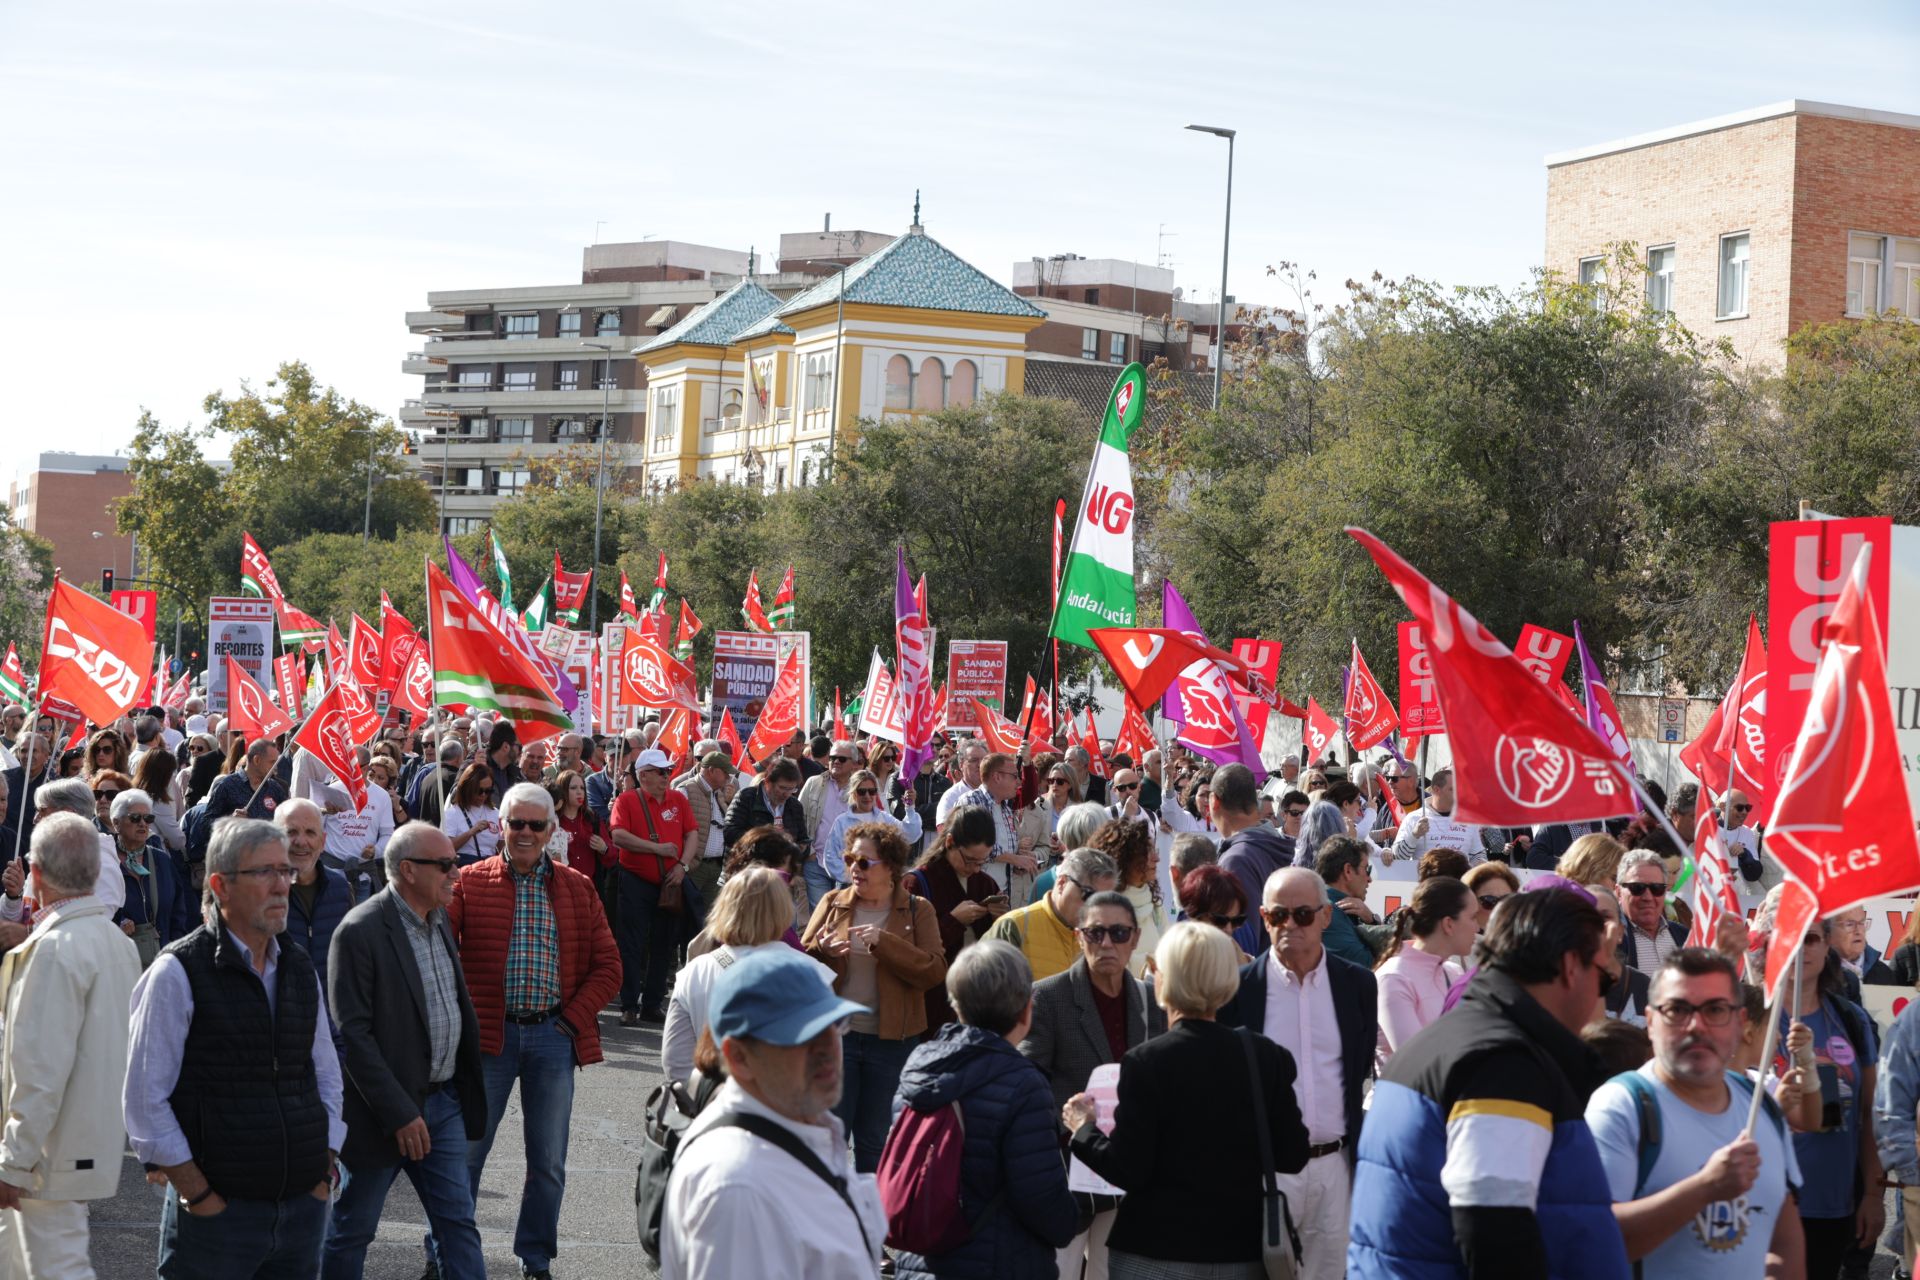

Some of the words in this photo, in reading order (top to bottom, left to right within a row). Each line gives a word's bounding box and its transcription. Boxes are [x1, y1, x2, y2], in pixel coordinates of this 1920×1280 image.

[1086, 481, 1134, 535] UG
[211, 602, 272, 616] CCOO
[1066, 589, 1133, 626] Andalucía
[214, 642, 265, 657] RECORTES
[715, 635, 777, 652] CCOO
[47, 616, 140, 709] CCOO
[964, 660, 1003, 668] SANIDAD
[1520, 631, 1562, 684] UG
[715, 662, 774, 683] SANIDAD
[957, 668, 994, 678] PÚBLICA
[1234, 644, 1270, 720] UT
[727, 680, 767, 697] PÚBLICA
